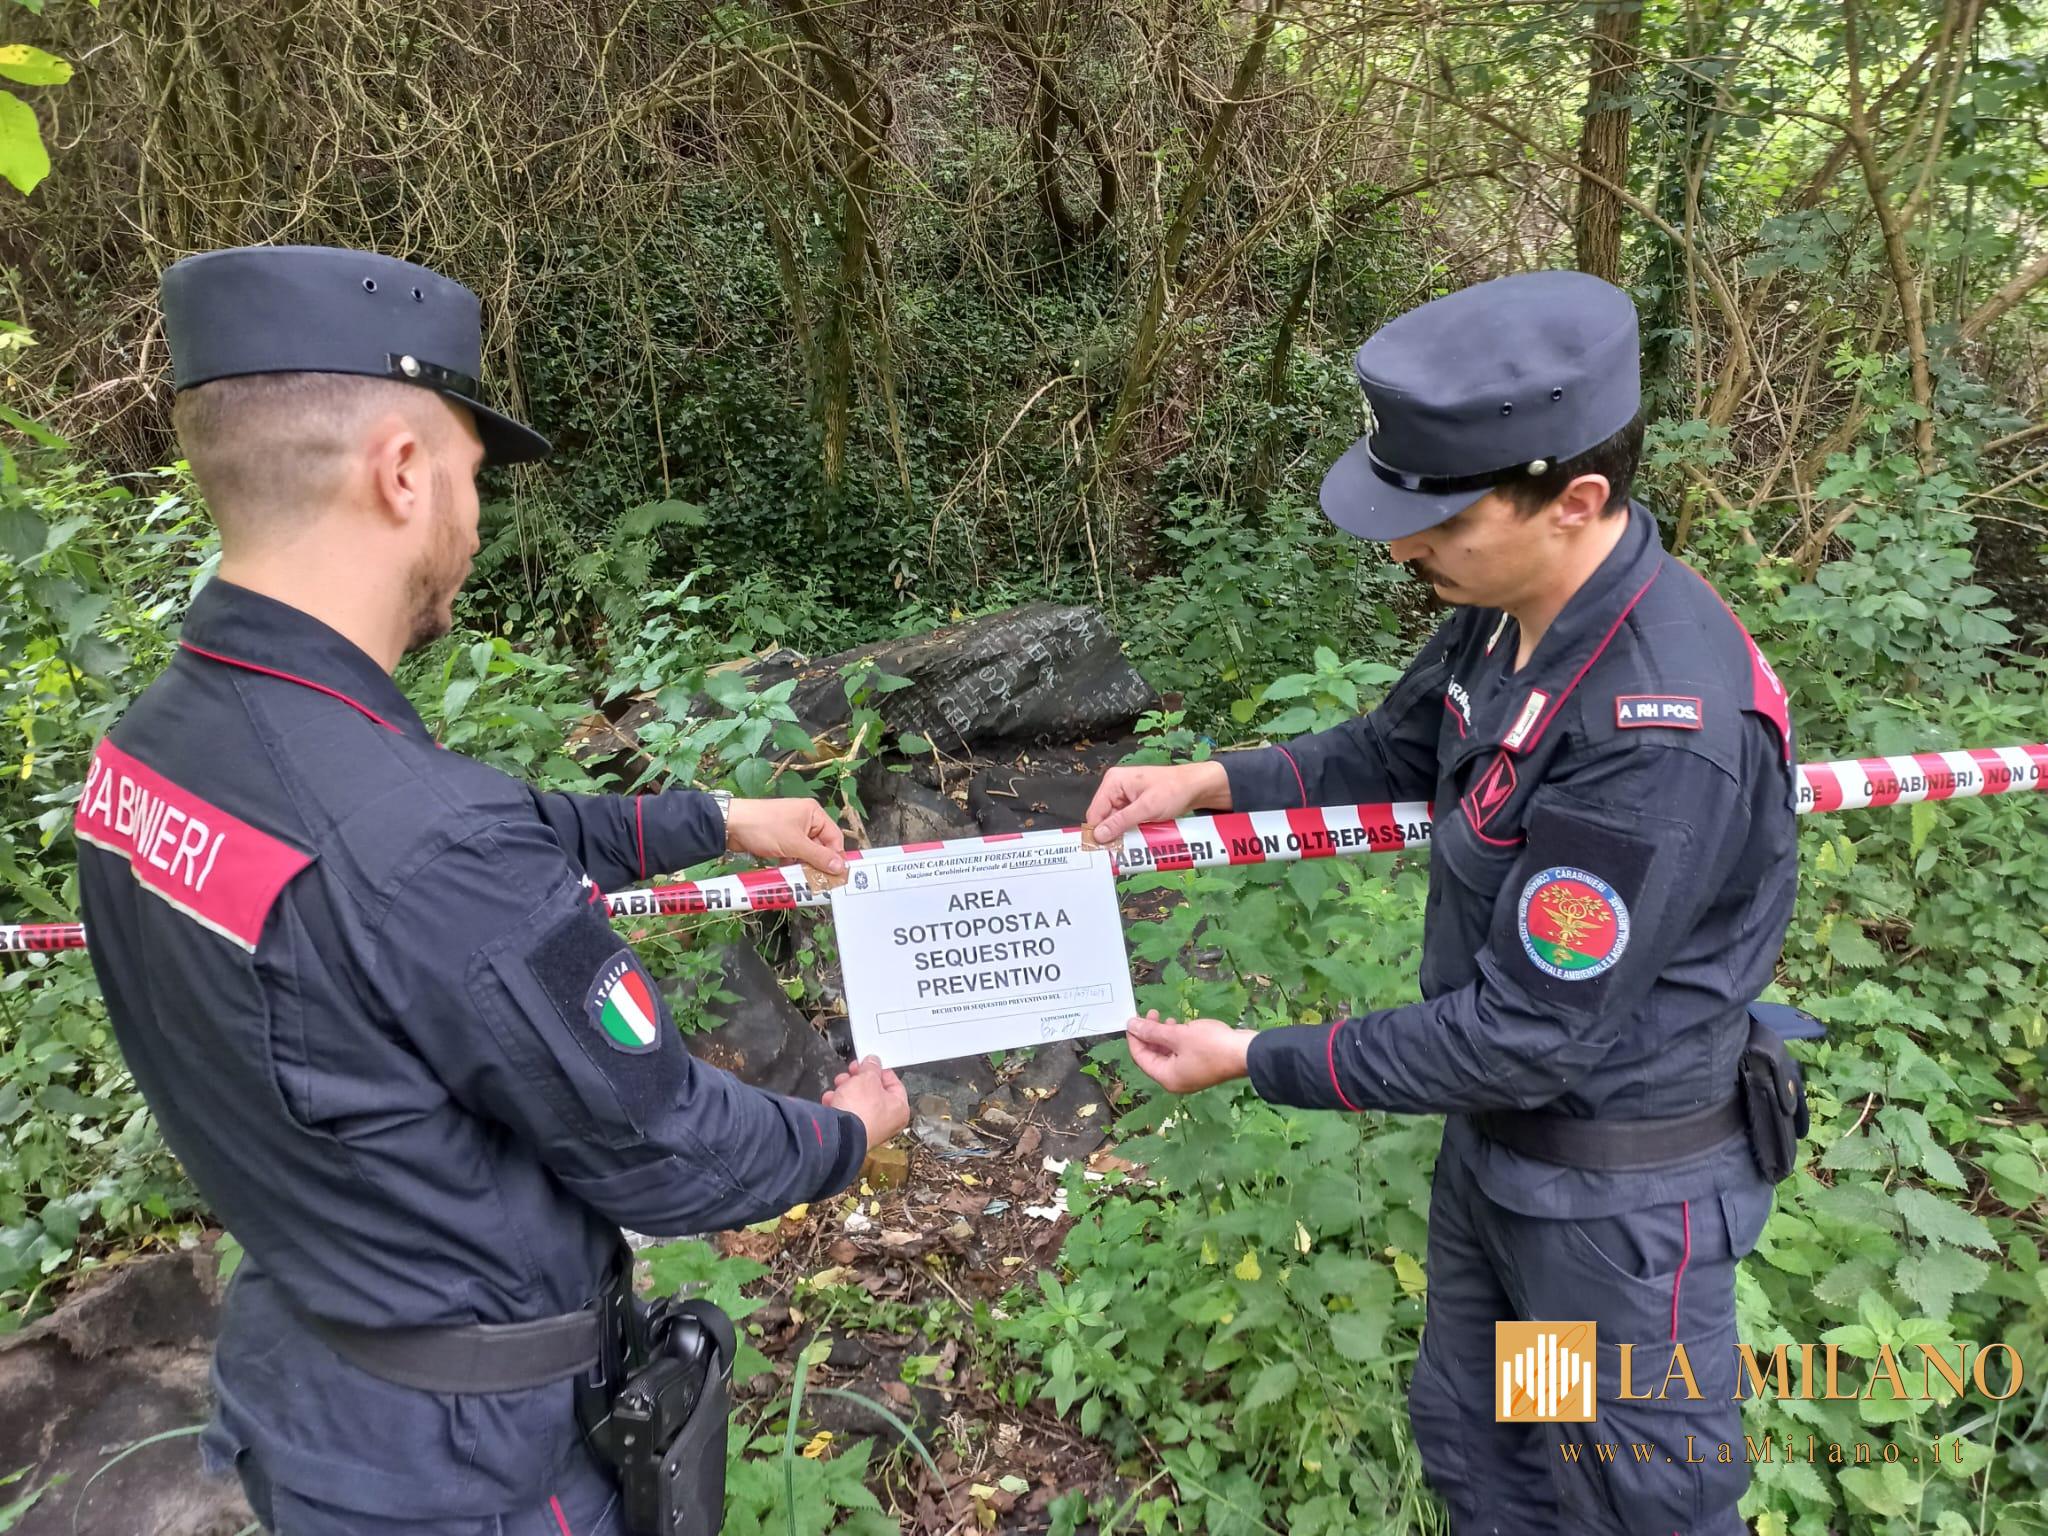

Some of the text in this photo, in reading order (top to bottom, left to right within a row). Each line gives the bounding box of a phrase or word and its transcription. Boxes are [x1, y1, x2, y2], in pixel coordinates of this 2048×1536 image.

[1620, 704, 1632, 718] A
[1636, 703, 1659, 717] RH
[1863, 771, 1973, 796] CARABINIERI
[1987, 766, 2024, 784] NON
[1231, 834, 1279, 858] NON
[1286, 821, 1432, 851] OLTREPASSAR
[886, 861, 926, 873] REGIONE
[926, 855, 983, 869] CARABINIERI
[984, 849, 1033, 862] FORESTALE
[1555, 869, 1607, 893] CARABINIERI
[610, 887, 732, 917] ABINIERI
[756, 882, 813, 907] NON
[948, 888, 1012, 912] AREA
[893, 908, 1072, 946] SOTTOPOSTA A
[914, 936, 1055, 971] SEQUESTRO
[1528, 949, 1562, 978] FORESTALE
[1563, 958, 1610, 979] AMBIENTALE
[594, 961, 629, 1008] ITALIA
[917, 963, 1061, 998] PREVENTIVO
[971, 1000, 1007, 1010] SEQUESTRO
[1008, 995, 1048, 1006] PREVENTIVO
